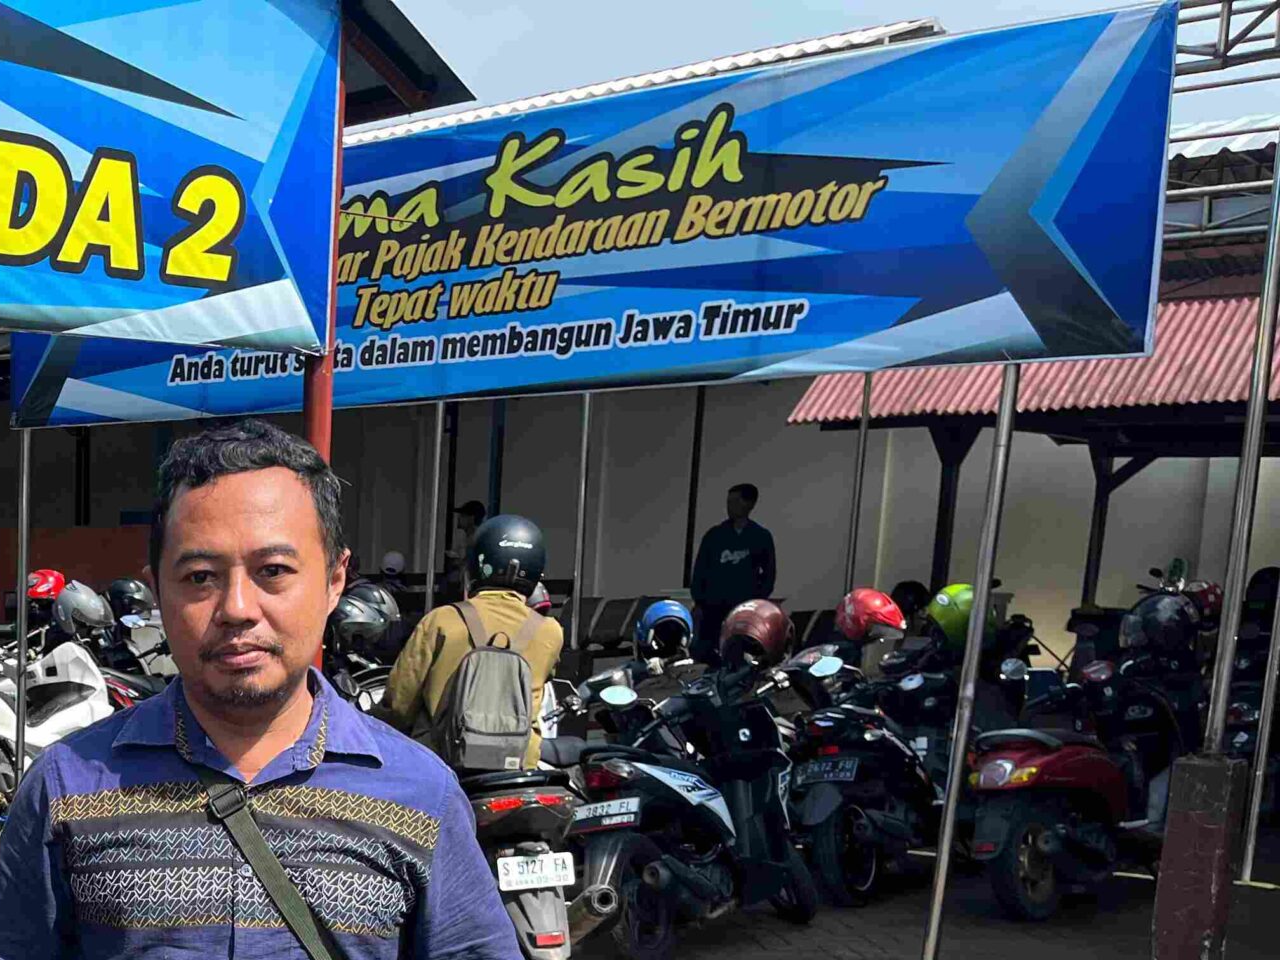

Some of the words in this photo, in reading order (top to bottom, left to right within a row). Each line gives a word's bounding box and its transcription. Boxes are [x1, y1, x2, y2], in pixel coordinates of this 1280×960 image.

[486, 110, 745, 219] Kasih
[165, 173, 241, 282] 2
[370, 229, 467, 281] Pajak
[471, 208, 666, 269] Kendaraan
[670, 175, 889, 243] Bermotor
[169, 354, 226, 382] Anda
[230, 349, 289, 378] turut
[293, 341, 353, 373] sta
[360, 336, 435, 367] dalam
[440, 316, 611, 361] membangun
[618, 311, 691, 344] Jawa
[701, 300, 804, 336] Timur
[352, 282, 444, 330] Tepat
[447, 272, 558, 320] waktu
[502, 862, 510, 876] S
[516, 859, 545, 876] 5127
[554, 857, 569, 872] FA
